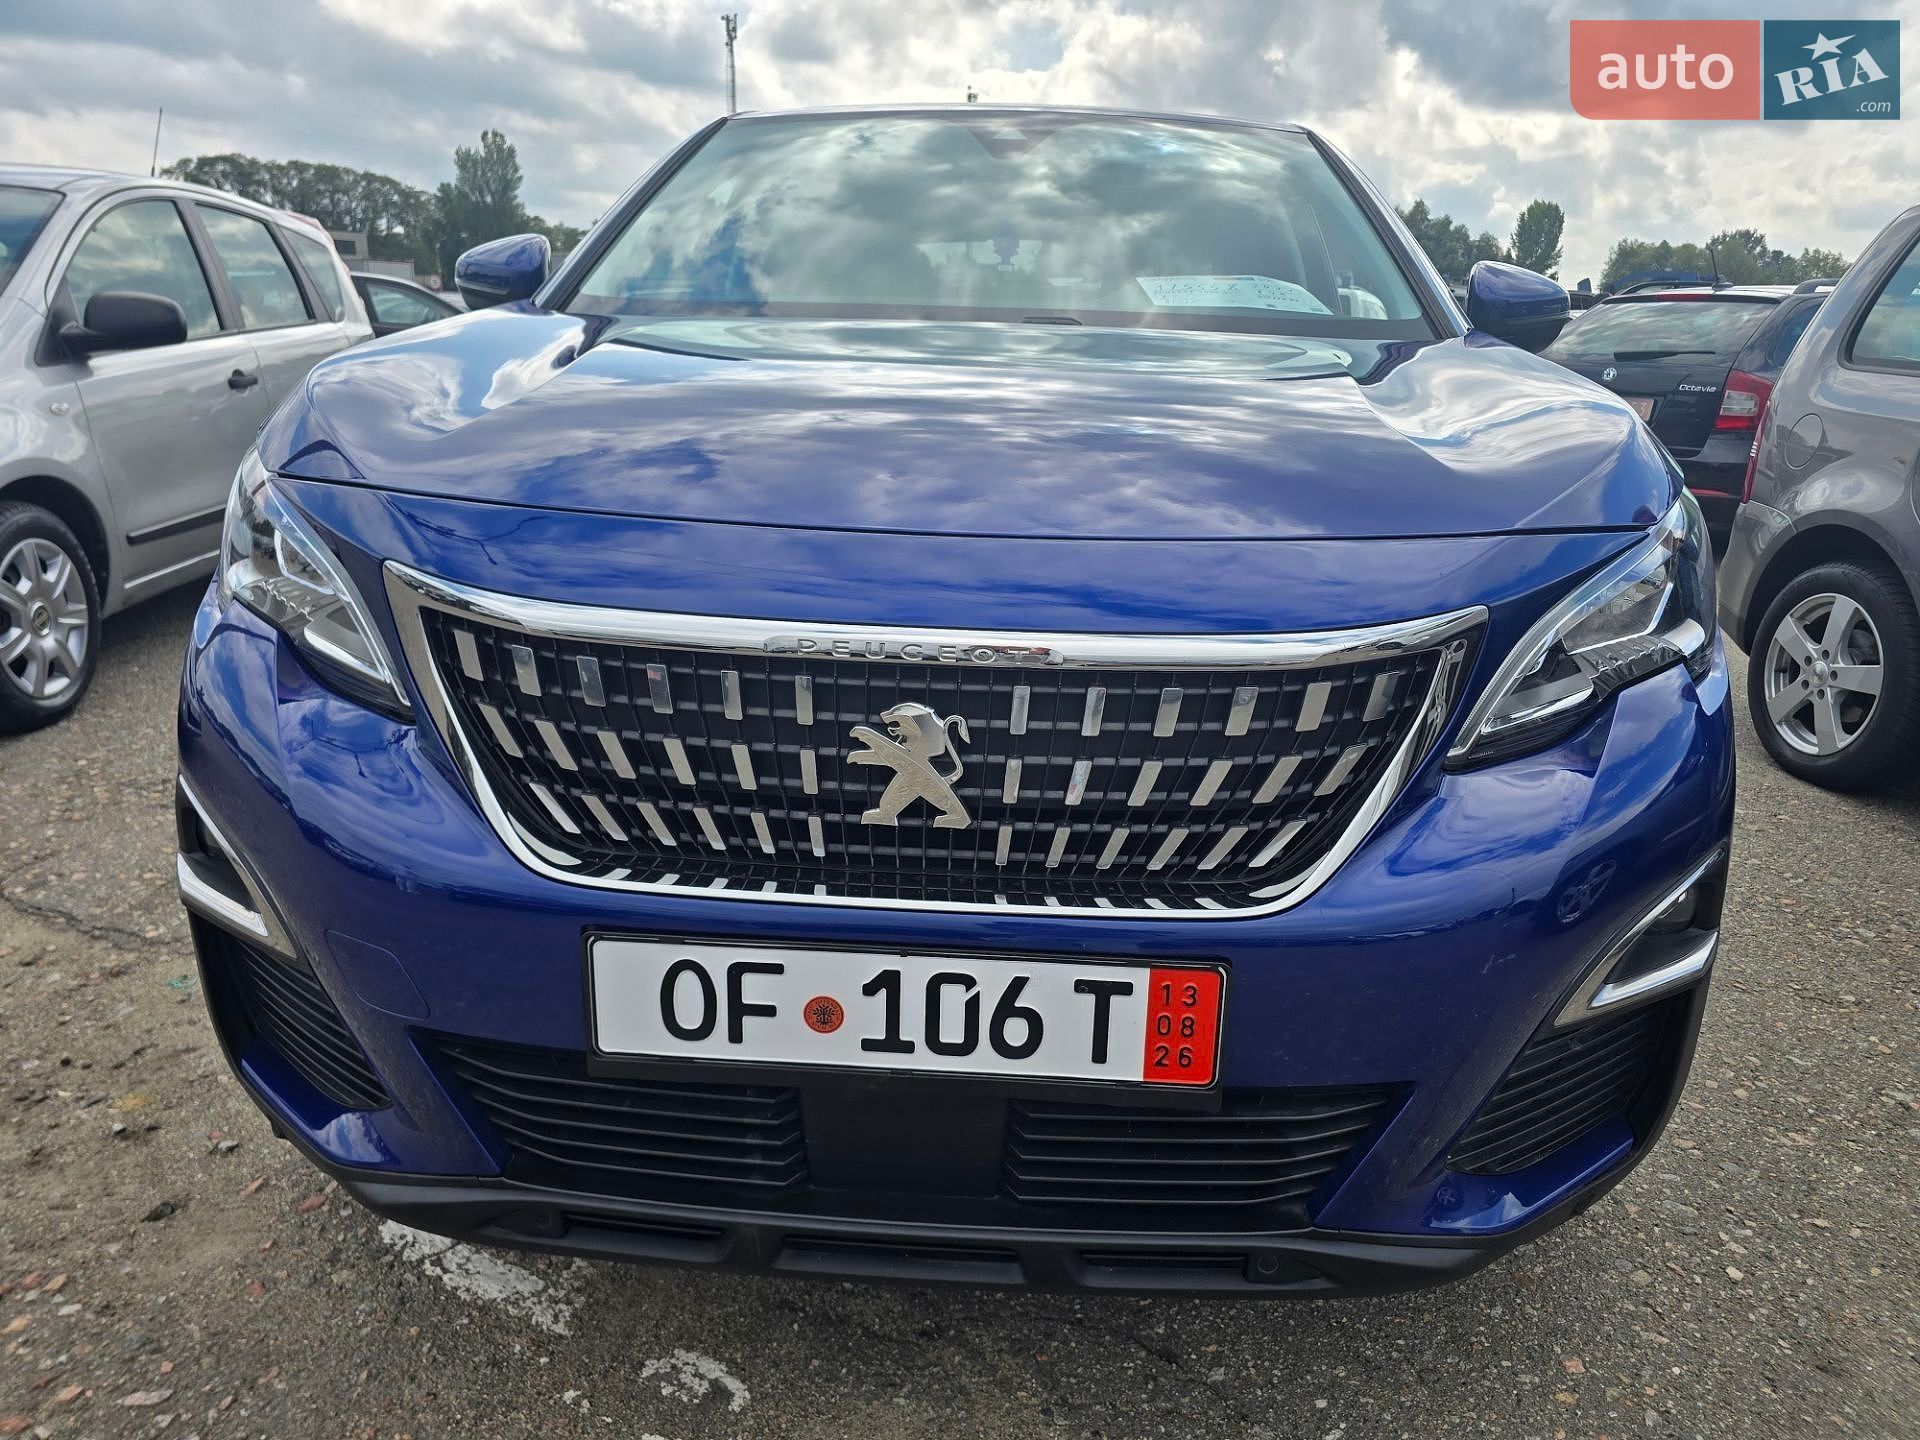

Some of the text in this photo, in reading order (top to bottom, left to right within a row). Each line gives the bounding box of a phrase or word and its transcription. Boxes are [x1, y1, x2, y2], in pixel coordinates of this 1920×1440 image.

[797, 638, 1031, 664] PEUGEOT
[1161, 984, 1197, 1007] 13
[660, 959, 785, 1044] OF
[860, 969, 1044, 1060] 106
[1073, 979, 1134, 1065] T
[1157, 1015, 1195, 1037] 08
[1155, 1045, 1193, 1067] 26
